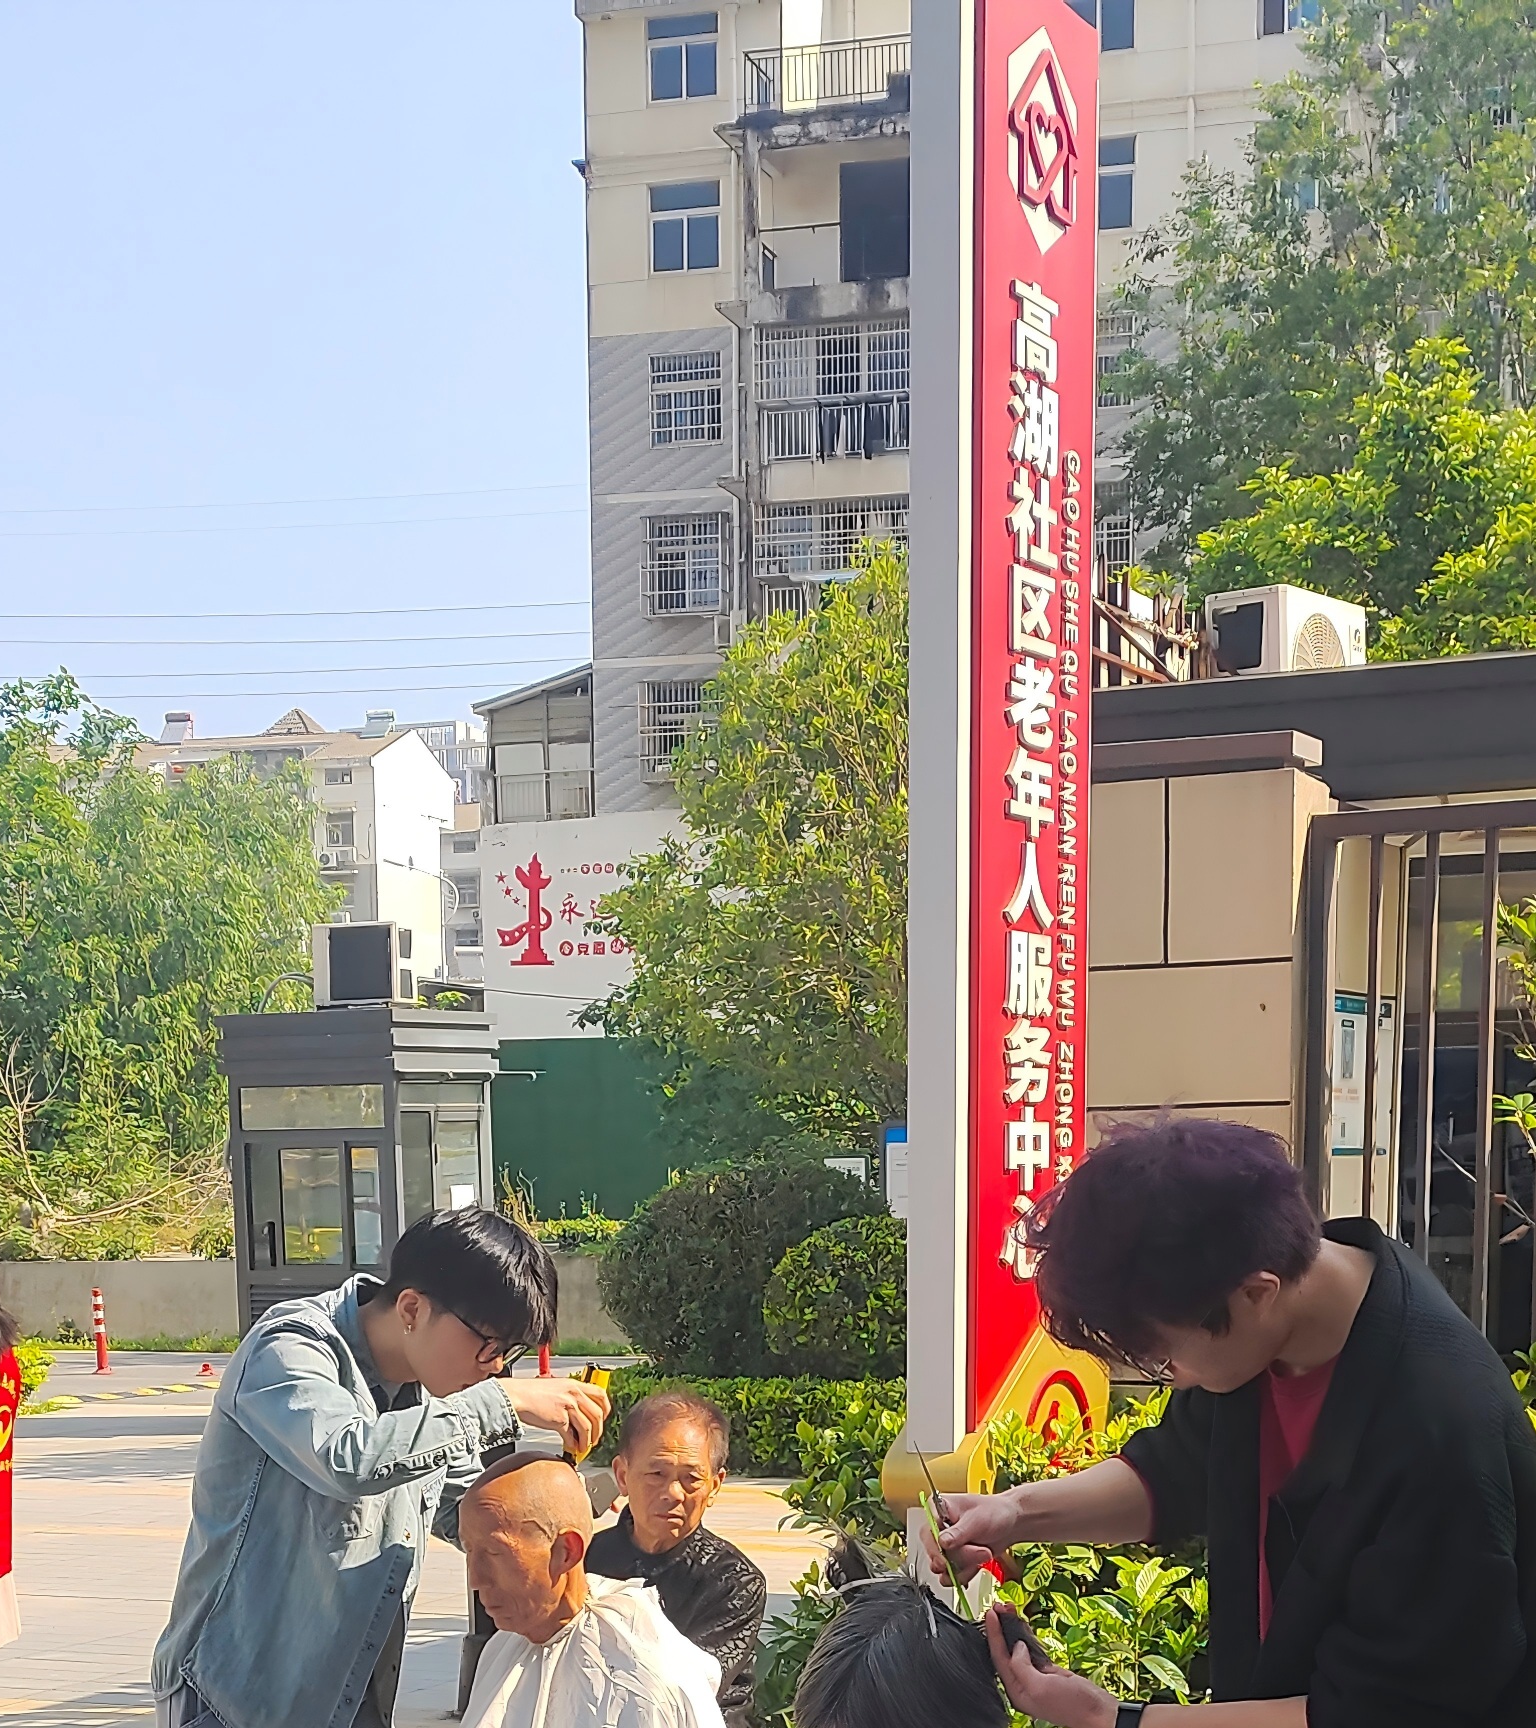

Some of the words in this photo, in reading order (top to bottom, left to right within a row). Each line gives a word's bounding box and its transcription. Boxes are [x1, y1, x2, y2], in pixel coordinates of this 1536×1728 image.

[1059, 709, 1079, 780] LAO
[1057, 863, 1077, 932] REN
[1054, 1040, 1074, 1156] ZHONG
